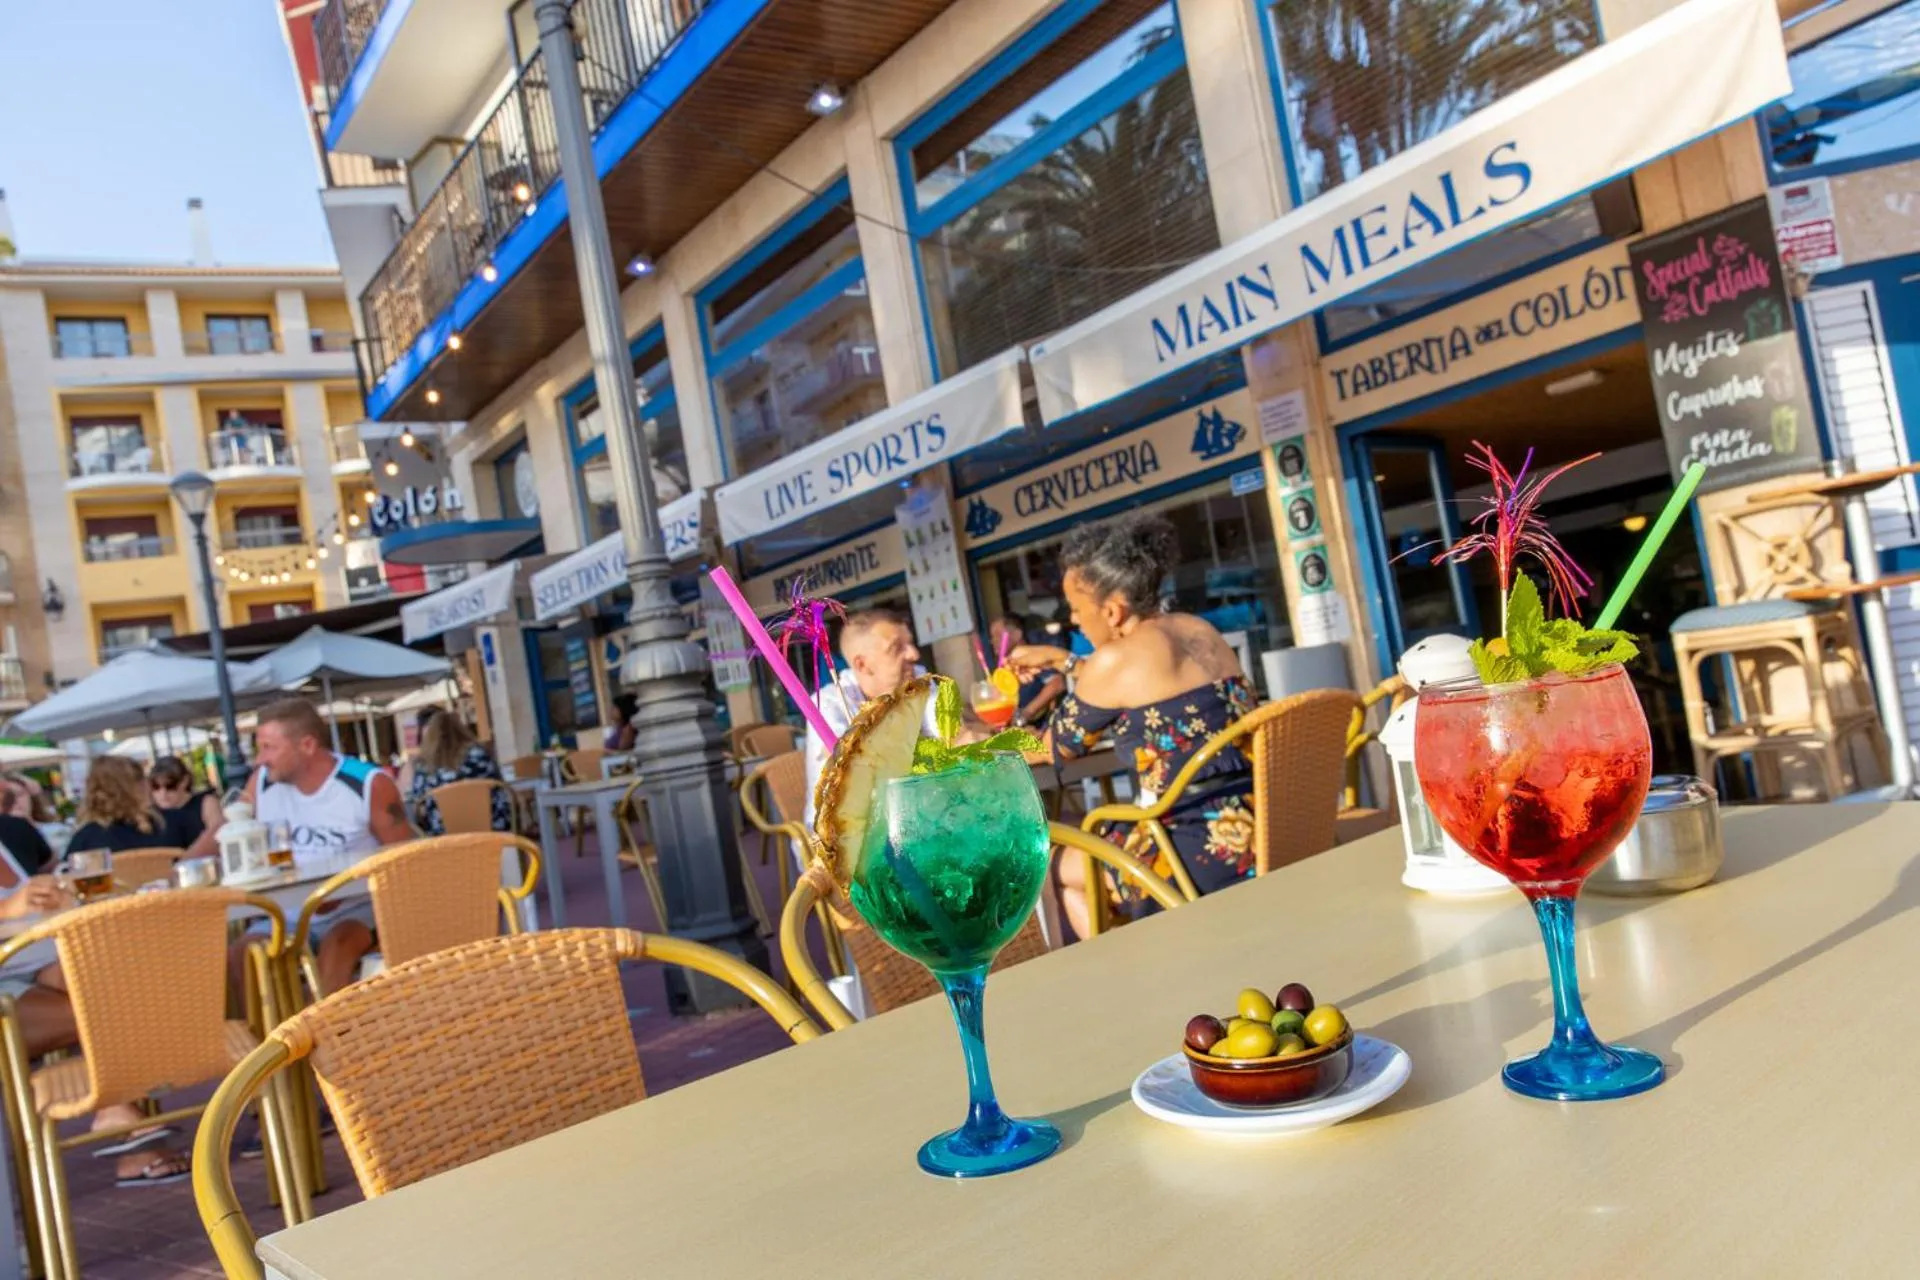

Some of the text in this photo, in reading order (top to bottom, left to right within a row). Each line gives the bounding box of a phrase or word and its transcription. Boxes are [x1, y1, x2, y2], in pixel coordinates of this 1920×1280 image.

[1151, 142, 1532, 362] MAIN MEALS
[1642, 236, 1712, 301] Special
[1330, 325, 1472, 401] TABERNA
[1653, 329, 1744, 379] Mojitos
[763, 412, 947, 521] LIVE SPORTS
[1013, 439, 1160, 518] CERVECERIA
[281, 822, 347, 847] OSS
